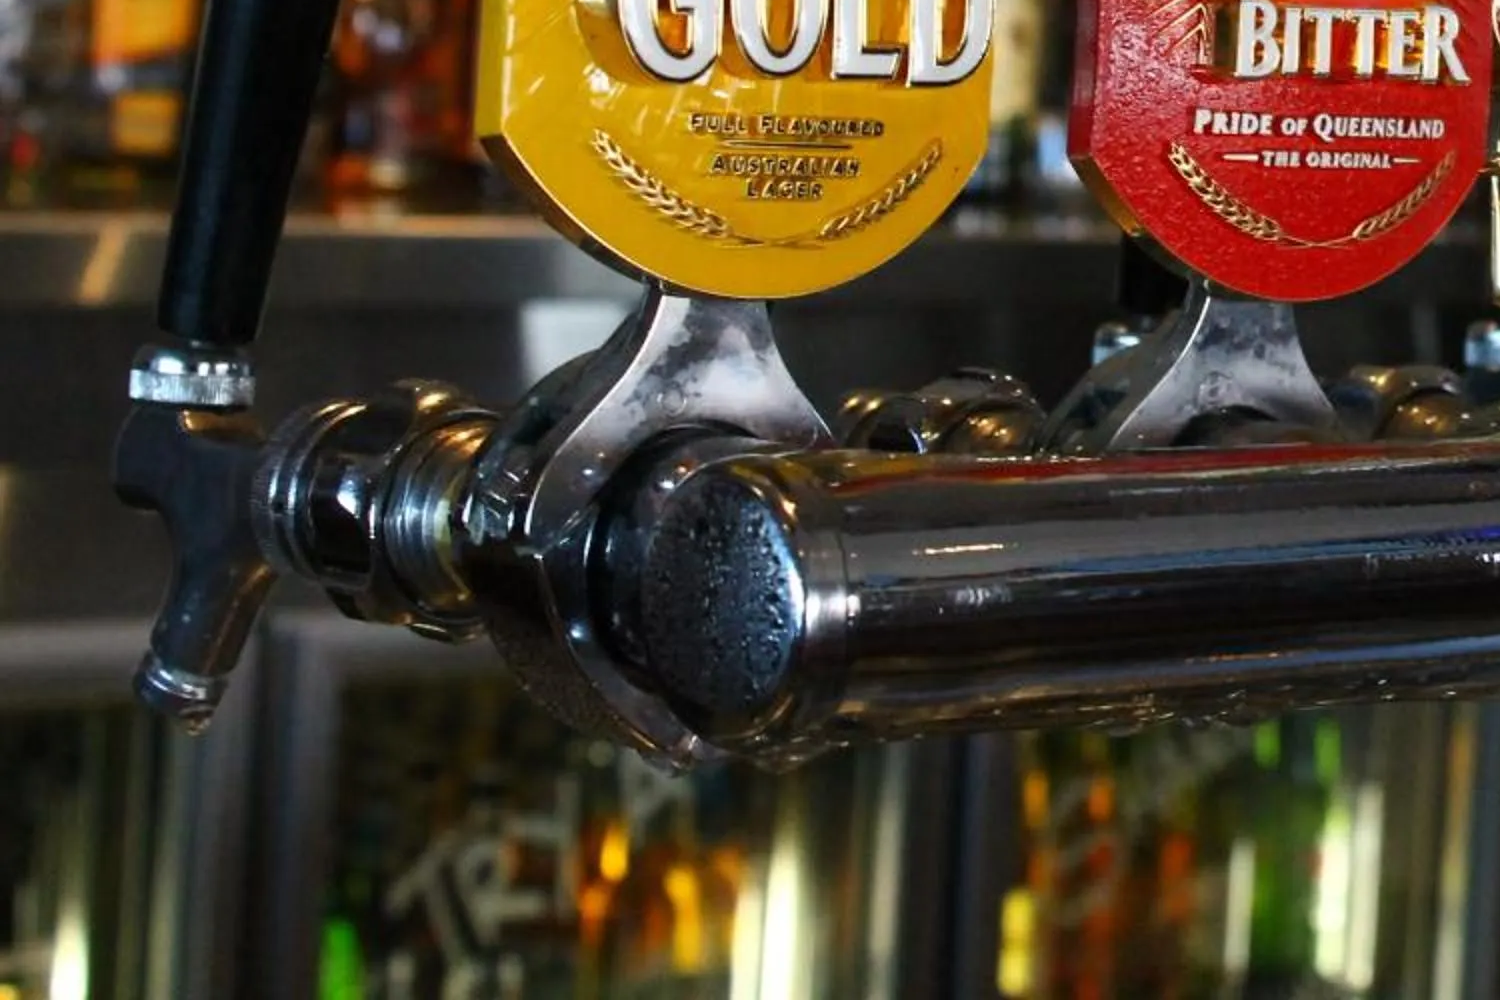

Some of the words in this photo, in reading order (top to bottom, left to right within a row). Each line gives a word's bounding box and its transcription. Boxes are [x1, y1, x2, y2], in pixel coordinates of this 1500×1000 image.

[688, 112, 748, 135] FULL
[1193, 108, 1273, 136] PRIDE
[1280, 117, 1309, 136] OF
[1312, 112, 1446, 143] QUEENSLAND
[709, 152, 862, 179] AUSTRALIAN
[1262, 150, 1300, 167] THE
[1305, 150, 1393, 169] ORIGINAL
[745, 178, 825, 201] LAGER
